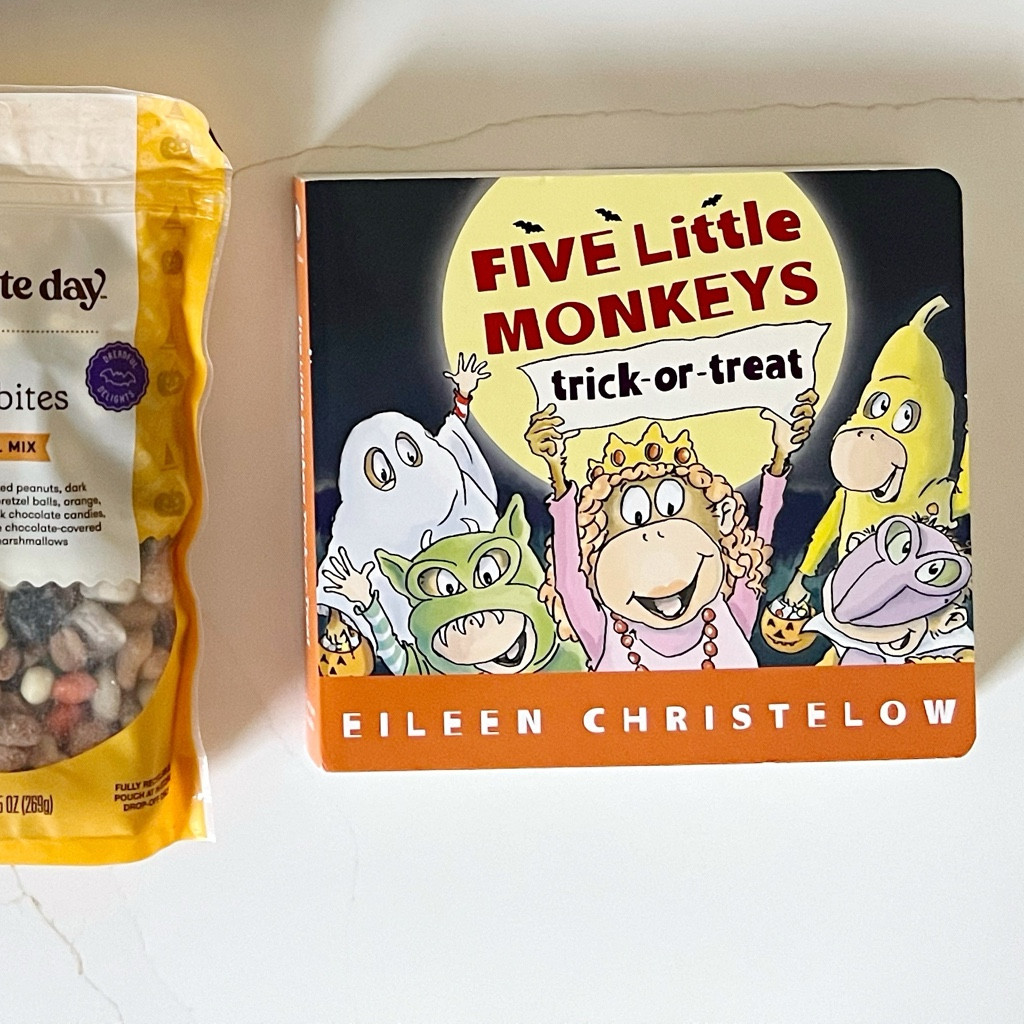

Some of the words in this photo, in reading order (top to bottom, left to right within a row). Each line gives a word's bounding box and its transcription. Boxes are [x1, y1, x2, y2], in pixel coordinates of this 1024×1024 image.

[471, 229, 620, 293] FIVE
[633, 201, 801, 266] Little
[483, 261, 819, 355] MONKEYS
[551, 349, 803, 401] trick-or-treat
[8, 440, 37, 454] MIX
[16, 483, 62, 495] peanuts,
[65, 481, 87, 492] dark
[32, 496, 61, 508] balls,
[63, 497, 102, 508] orange,
[8, 509, 61, 520] chocolate
[63, 508, 106, 520] candies,
[5, 522, 102, 533] chocolate-covered
[342, 709, 542, 738] EILEEN
[582, 699, 957, 735] CHRISTELOW
[115, 782, 141, 792] FULLY
[114, 791, 145, 802] POUCH
[6, 795, 19, 814] OZ
[22, 795, 54, 816] (269g)
